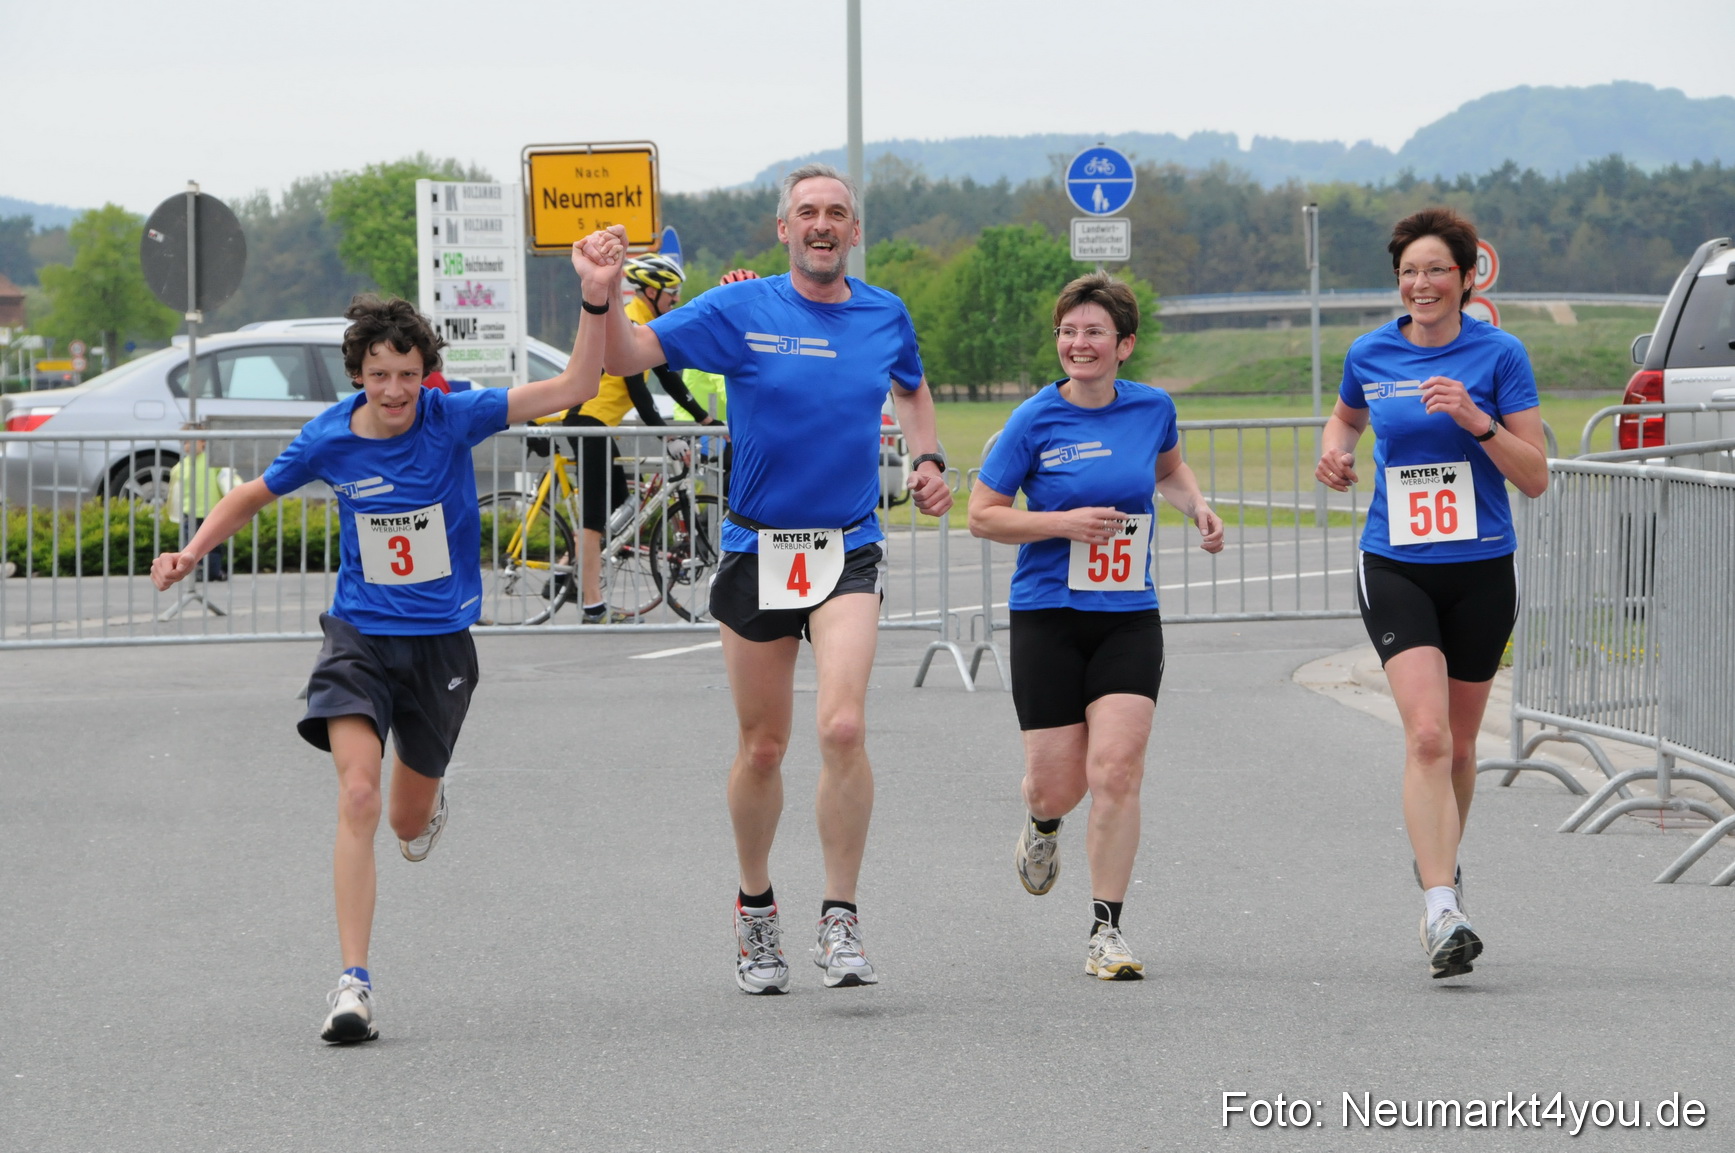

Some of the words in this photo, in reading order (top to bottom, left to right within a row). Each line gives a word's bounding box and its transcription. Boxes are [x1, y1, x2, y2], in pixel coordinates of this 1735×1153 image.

[575, 166, 609, 178] Nach
[543, 185, 643, 210] Neumarkt
[577, 218, 585, 230] 5
[444, 317, 477, 340] THULE
[1400, 468, 1439, 479] MEYER
[1400, 477, 1441, 486] WERBUNG
[1409, 489, 1458, 537] 56
[370, 516, 411, 527] MEYER
[371, 525, 412, 533] WERBUNG
[773, 533, 811, 543] MEYER
[773, 542, 812, 550] WERBUNG
[388, 535, 414, 577] 3
[1087, 538, 1132, 583] 55
[786, 552, 812, 598] 4
